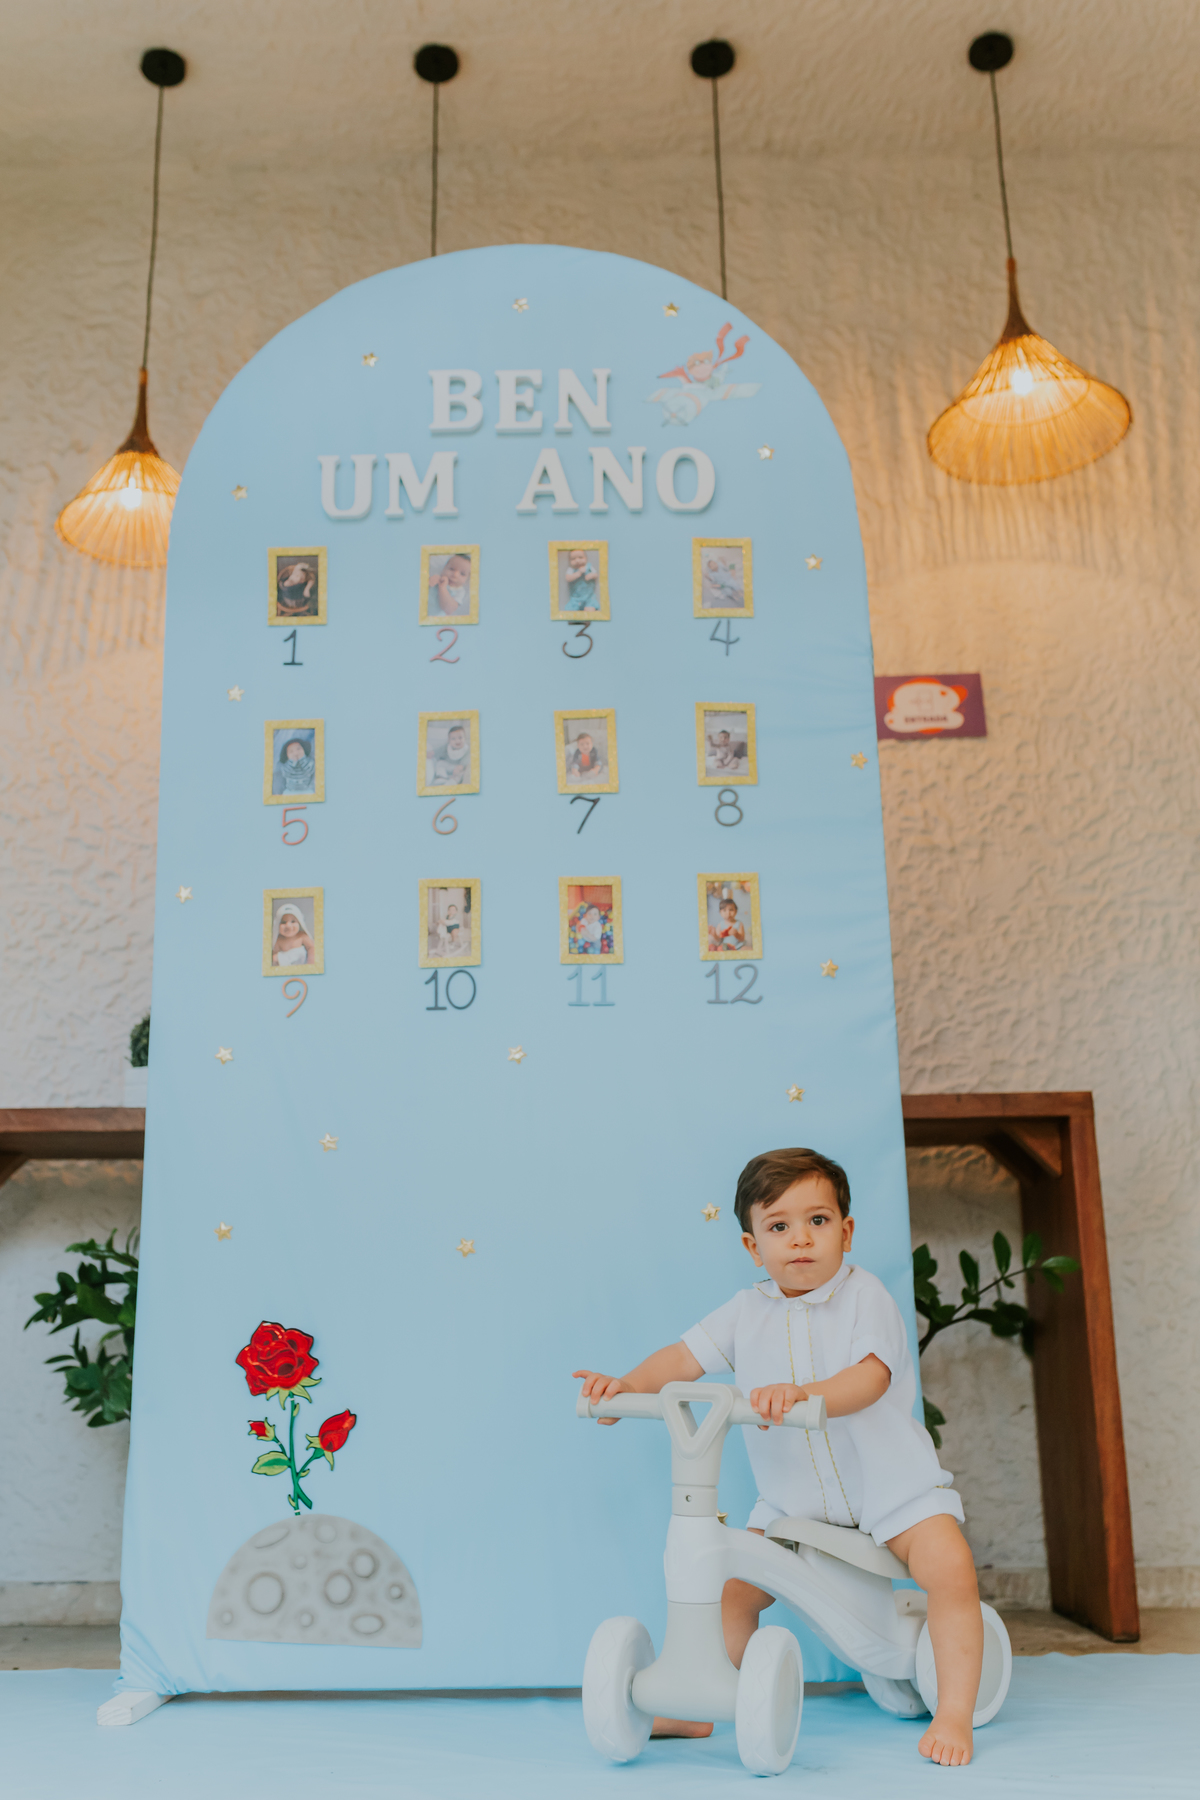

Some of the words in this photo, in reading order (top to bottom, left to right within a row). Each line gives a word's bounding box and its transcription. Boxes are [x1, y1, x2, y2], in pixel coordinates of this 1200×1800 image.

[428, 368, 612, 434] BEN
[317, 451, 459, 521] UM
[516, 446, 716, 513] ANO
[283, 629, 303, 665] 1
[429, 628, 460, 663] 2
[562, 621, 593, 658] 3
[709, 619, 740, 656] 4
[281, 806, 308, 846] 5
[432, 798, 458, 835] 6
[570, 796, 600, 834] 7
[714, 789, 743, 827] 8
[282, 978, 308, 1018] 9
[424, 970, 476, 1011] 10
[567, 965, 615, 1007] 11
[705, 963, 763, 1005] 12
